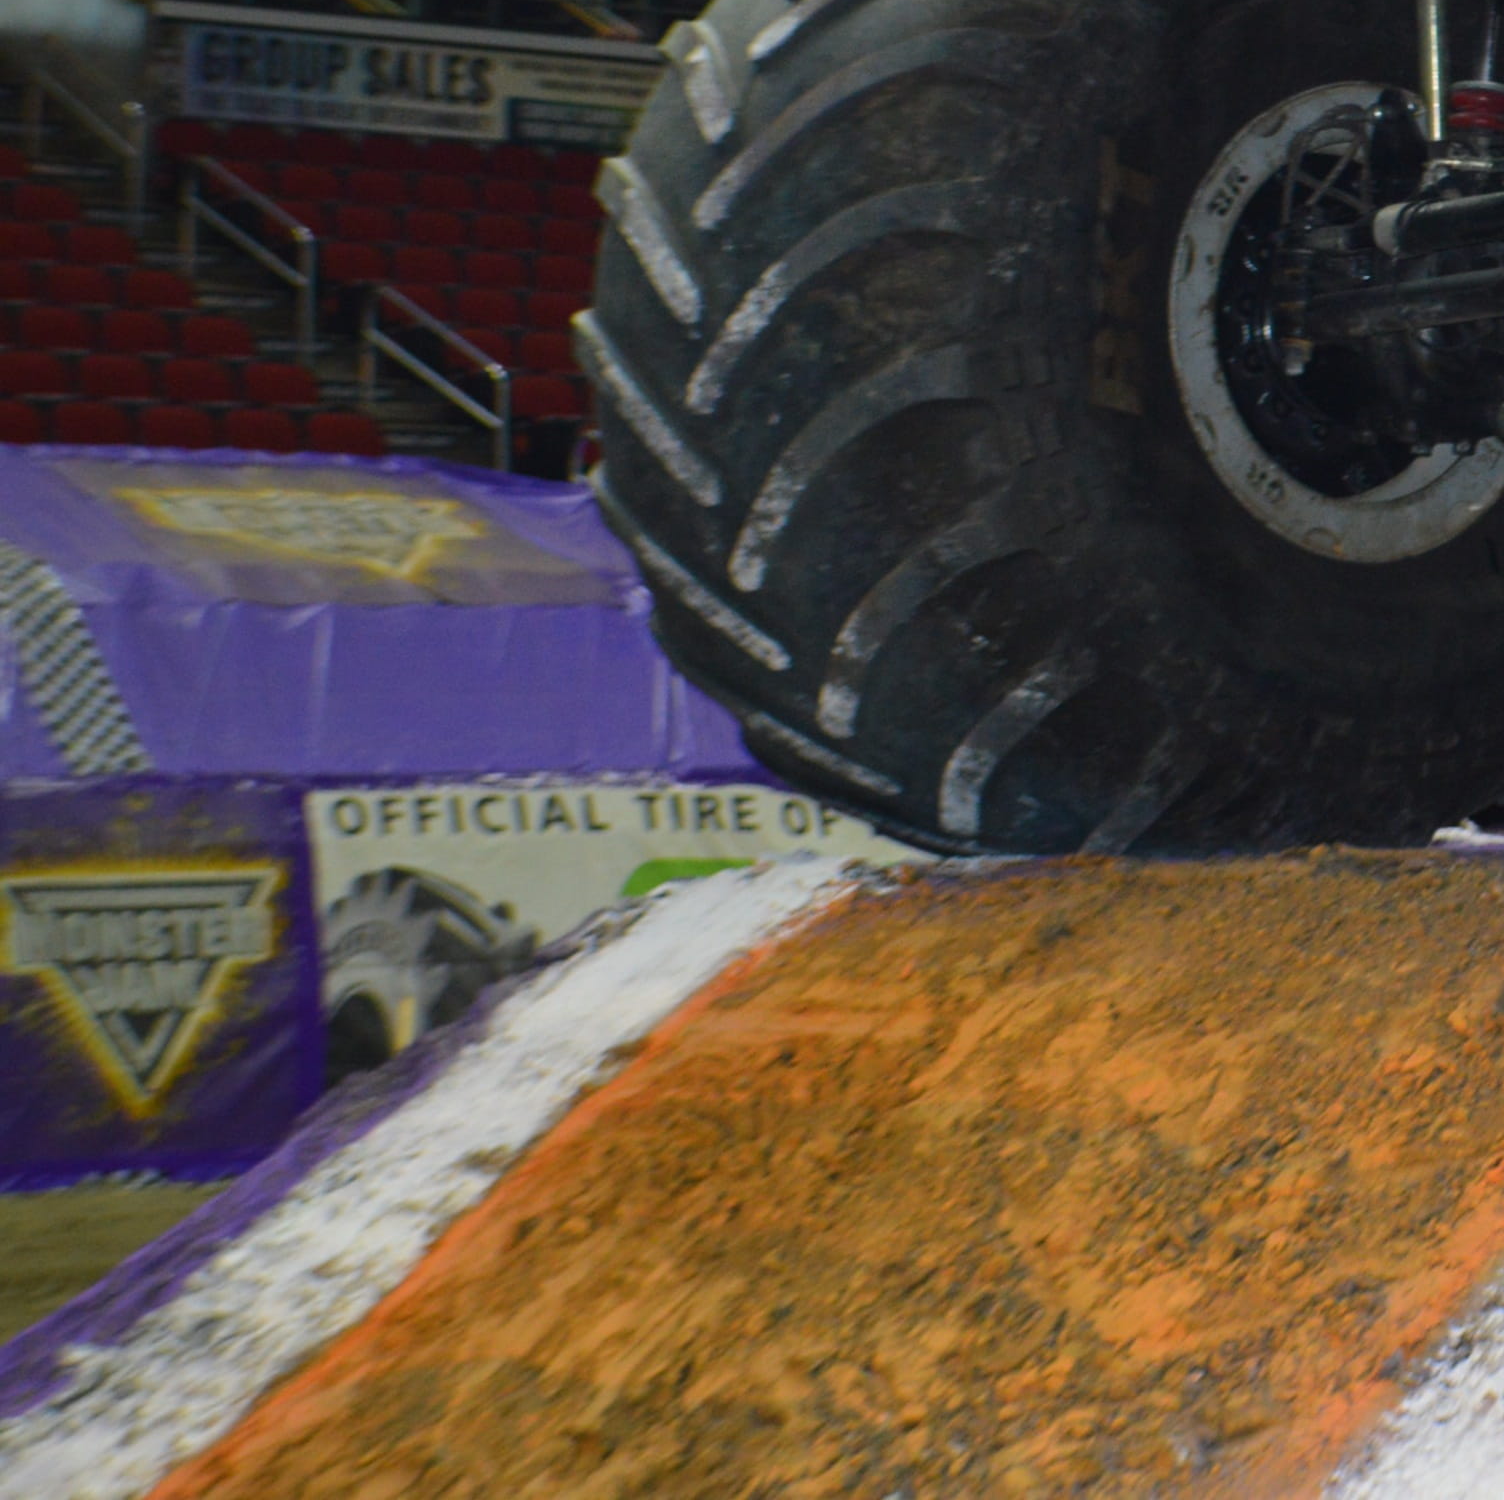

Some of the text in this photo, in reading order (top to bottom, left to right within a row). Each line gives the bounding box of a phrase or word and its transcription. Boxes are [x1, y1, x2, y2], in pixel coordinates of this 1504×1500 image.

[200, 31, 348, 91] GROUP
[363, 46, 495, 106] SALES
[331, 794, 609, 837] OFFICIAL
[637, 792, 761, 835] TIRE
